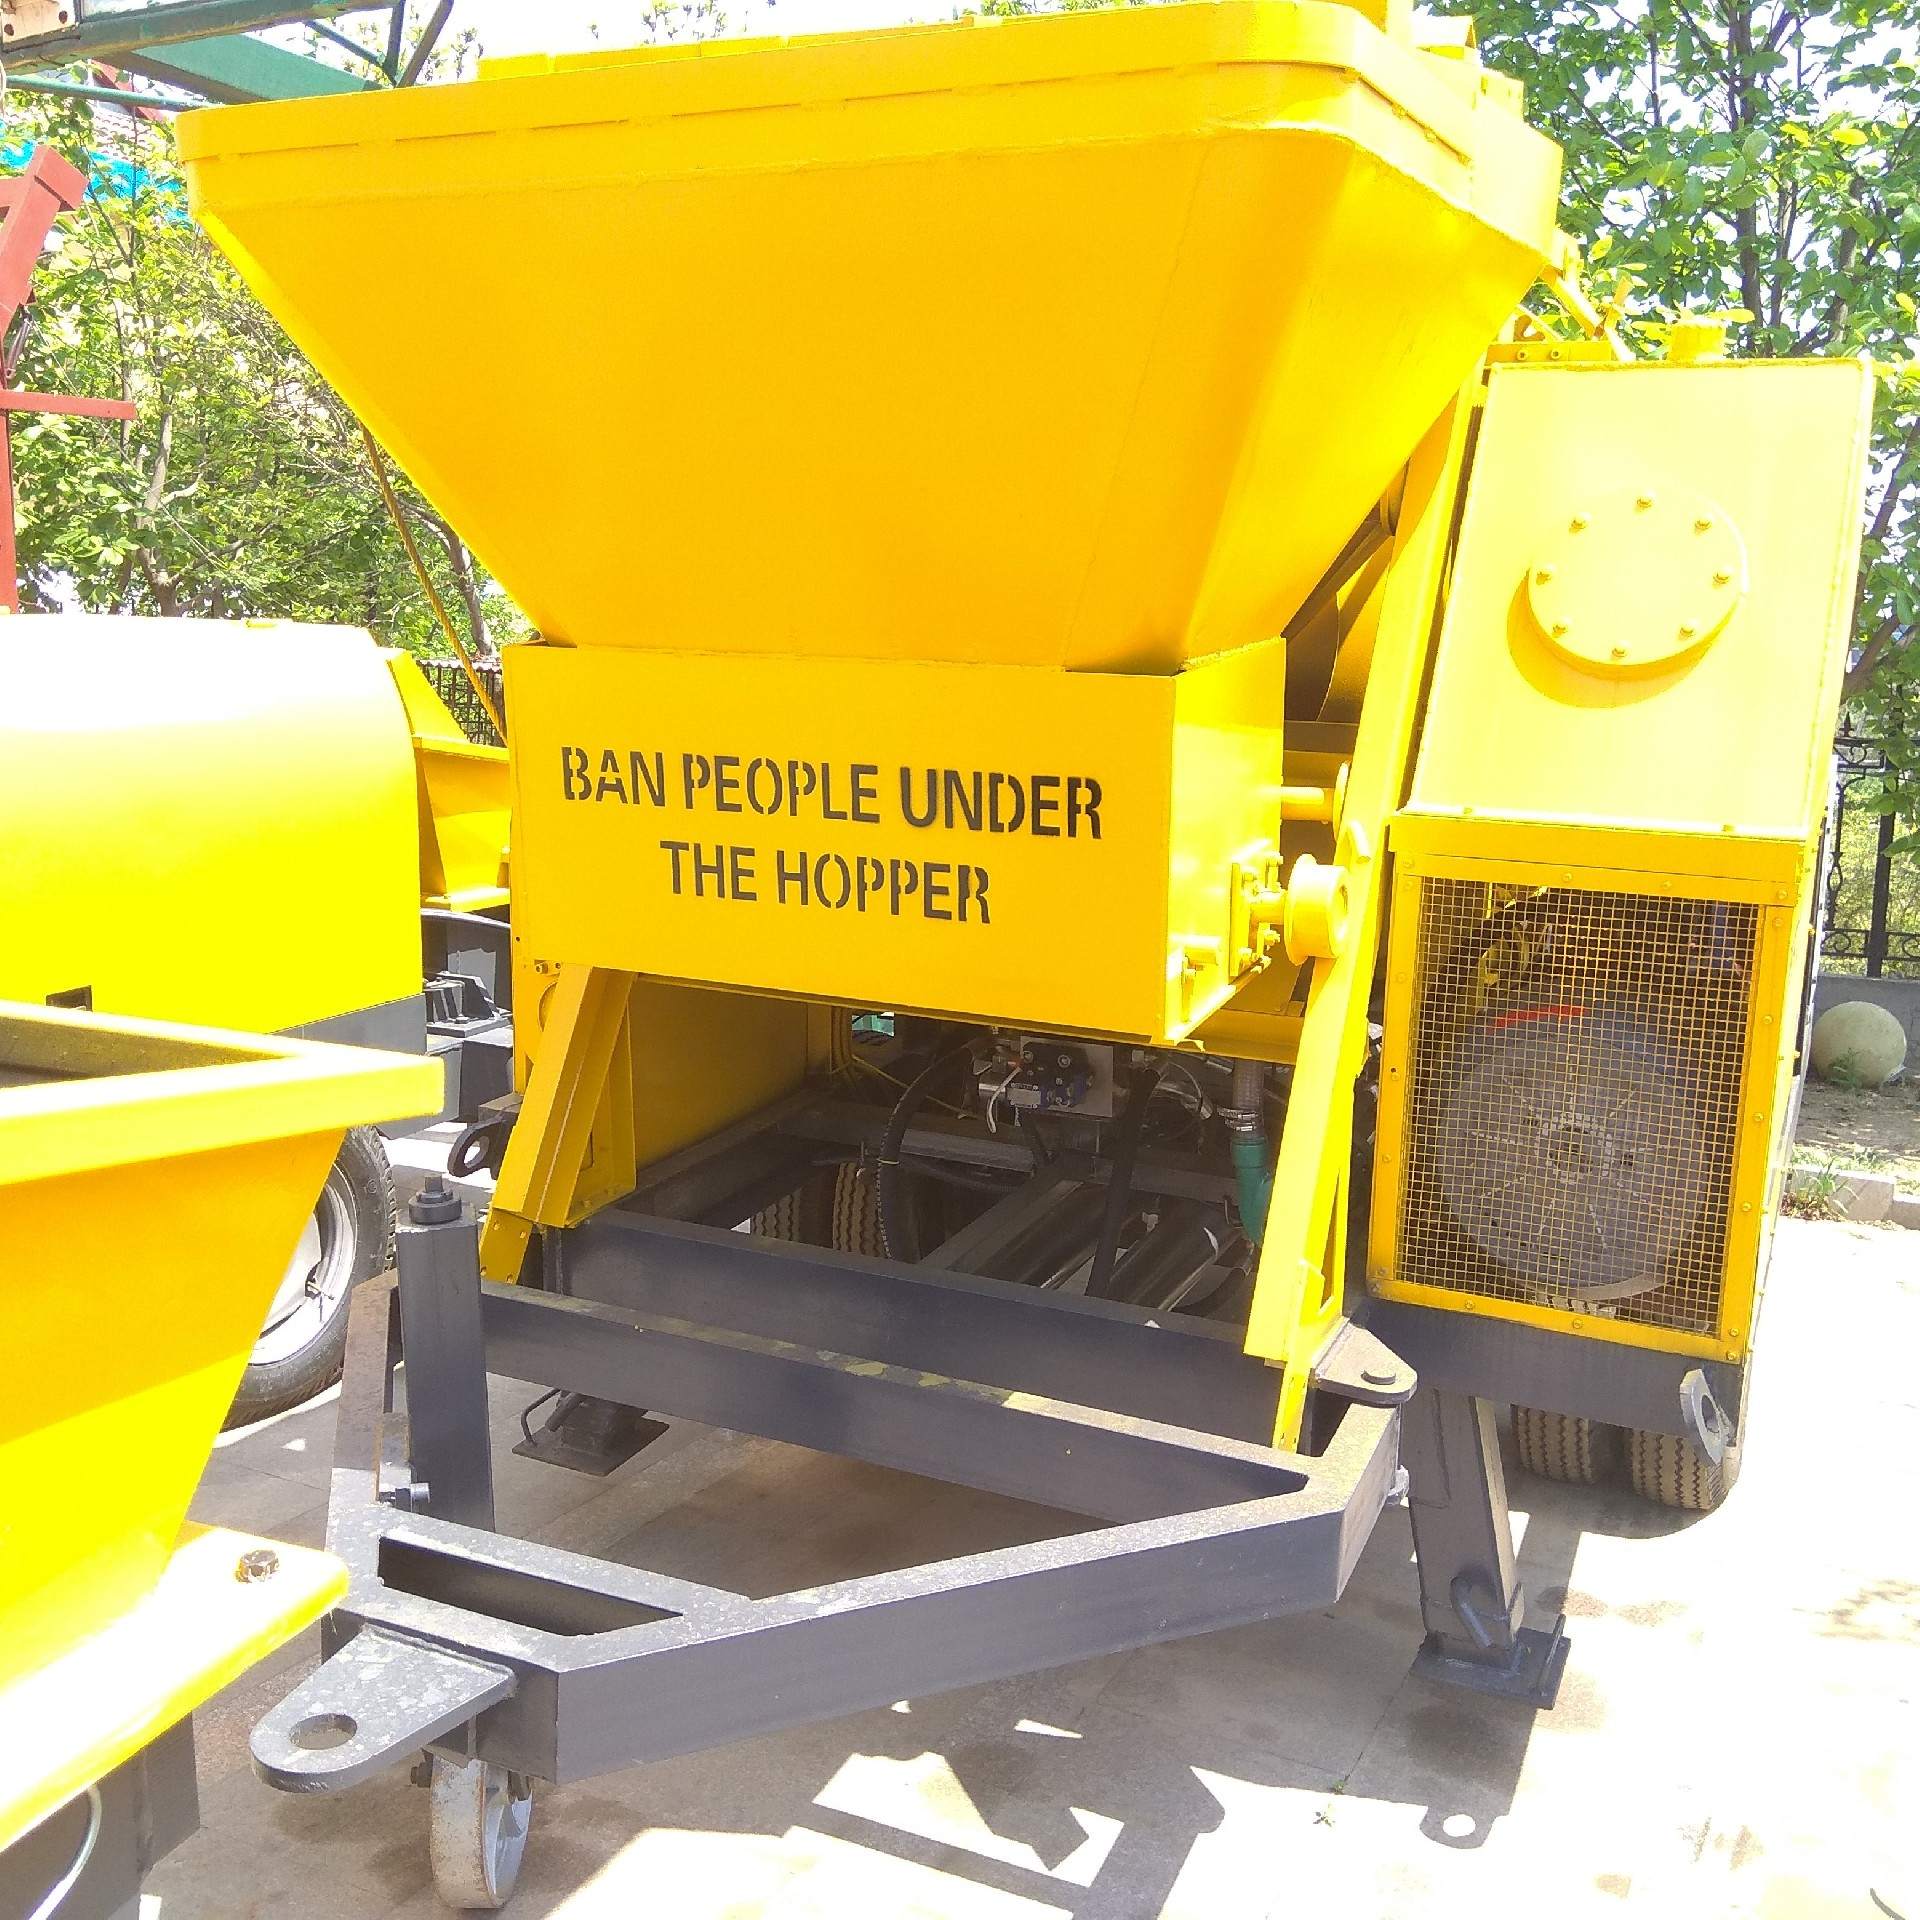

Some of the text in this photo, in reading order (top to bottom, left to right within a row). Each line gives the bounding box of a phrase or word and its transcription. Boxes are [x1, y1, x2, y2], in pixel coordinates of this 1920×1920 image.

[561, 746, 1104, 841] BAN PEOPLE UNDER
[659, 840, 992, 925] THE HOPPER
